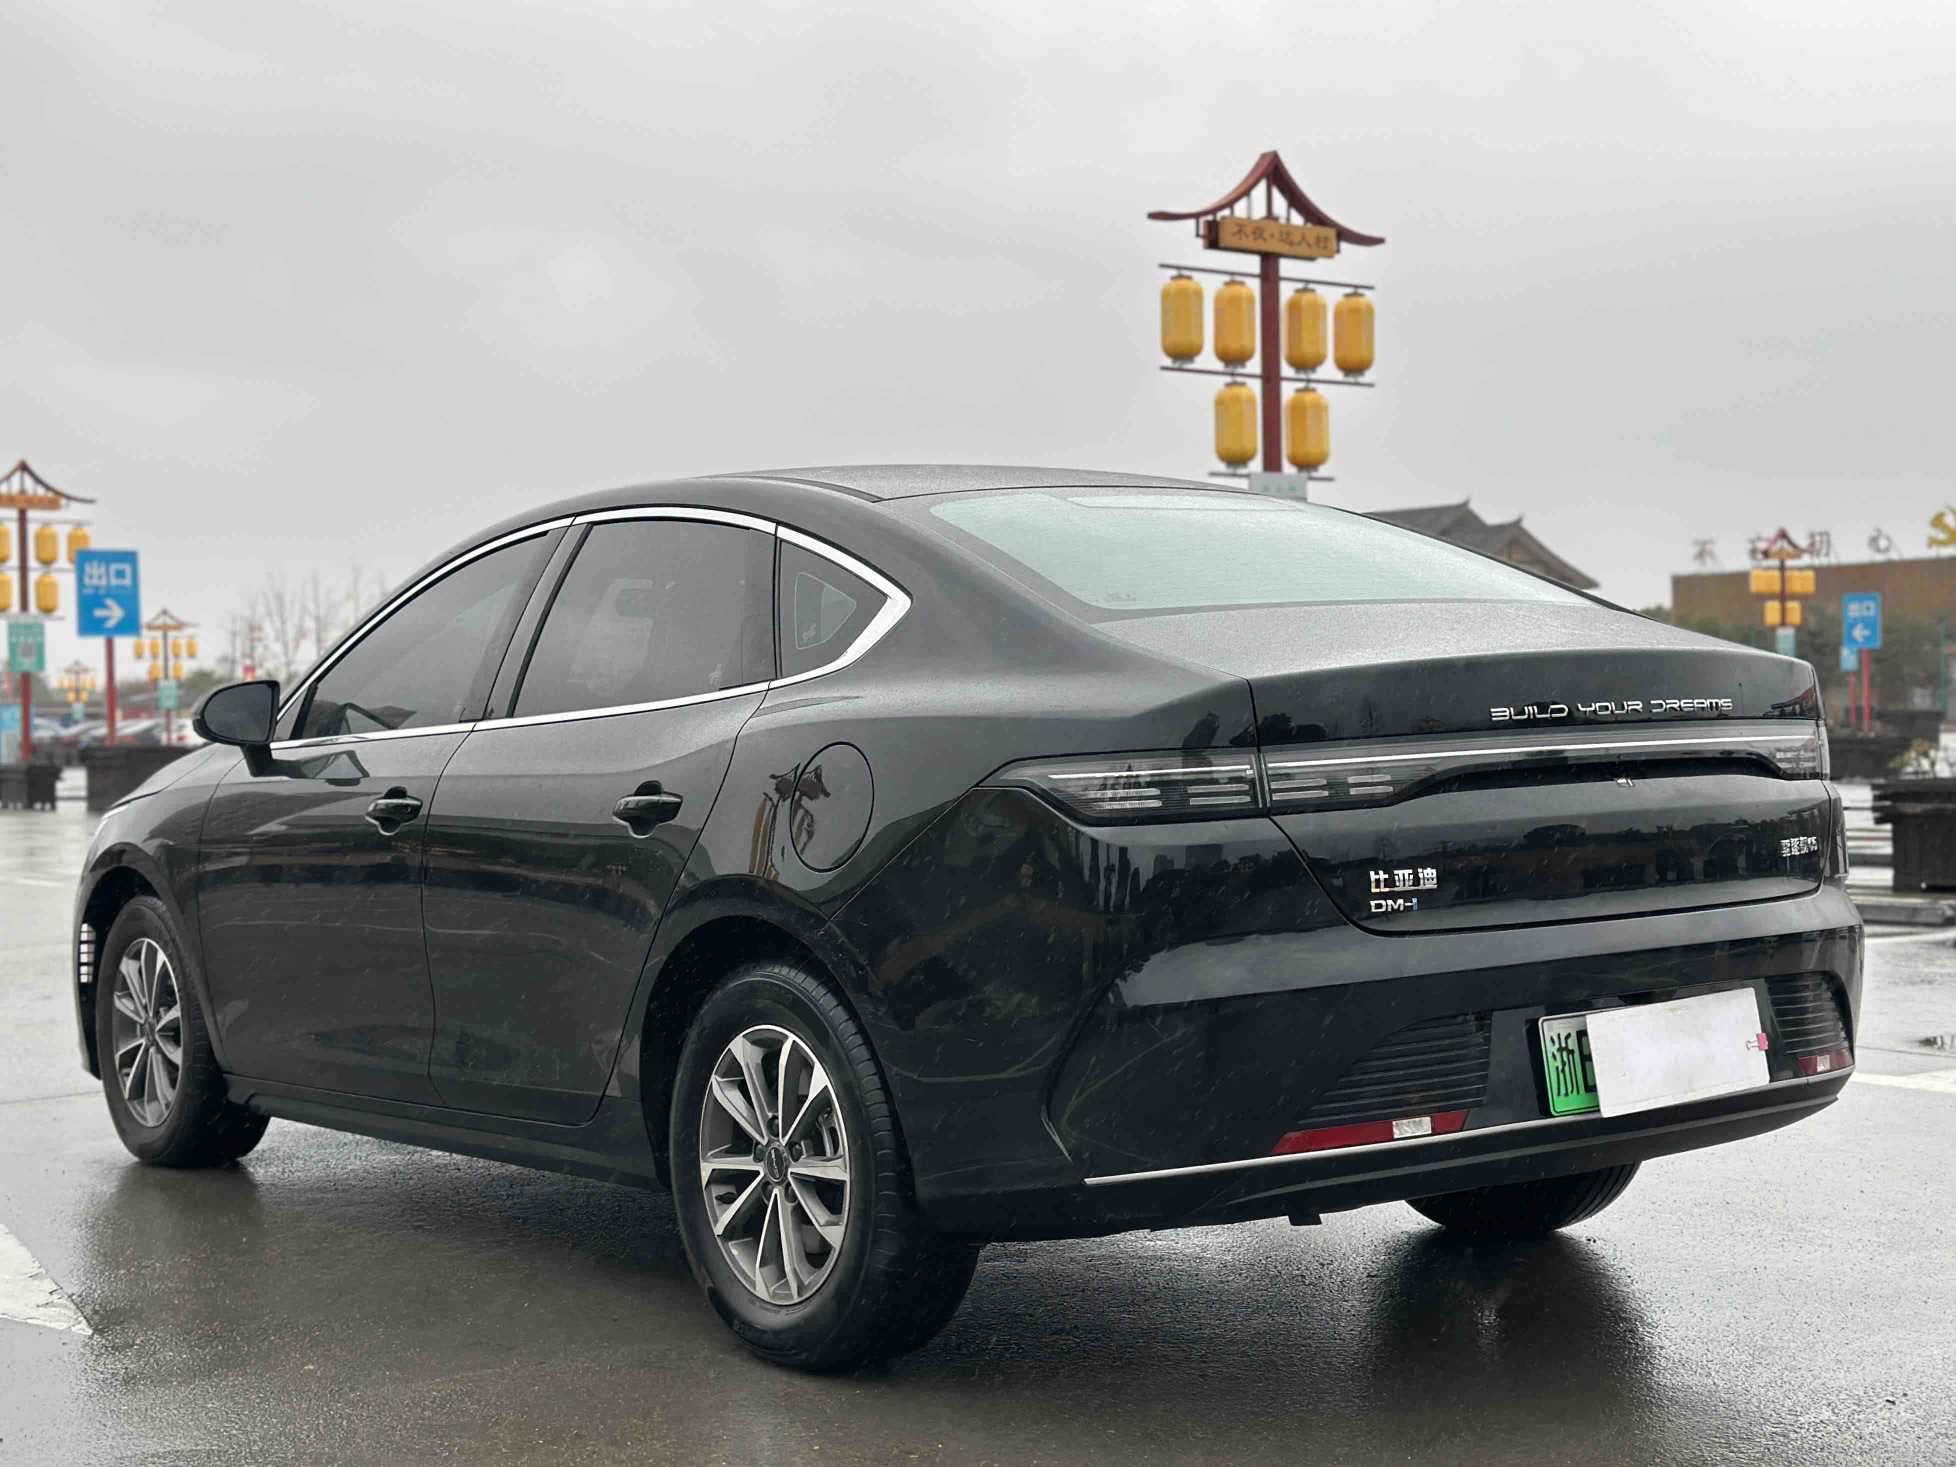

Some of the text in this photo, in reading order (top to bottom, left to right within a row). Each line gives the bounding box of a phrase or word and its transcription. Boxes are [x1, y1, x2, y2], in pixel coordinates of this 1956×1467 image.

[84, 561, 132, 586] 出口
[1490, 698, 1733, 721] BUILD YOUR DREAMS
[1369, 867, 1438, 893] 比亚迪
